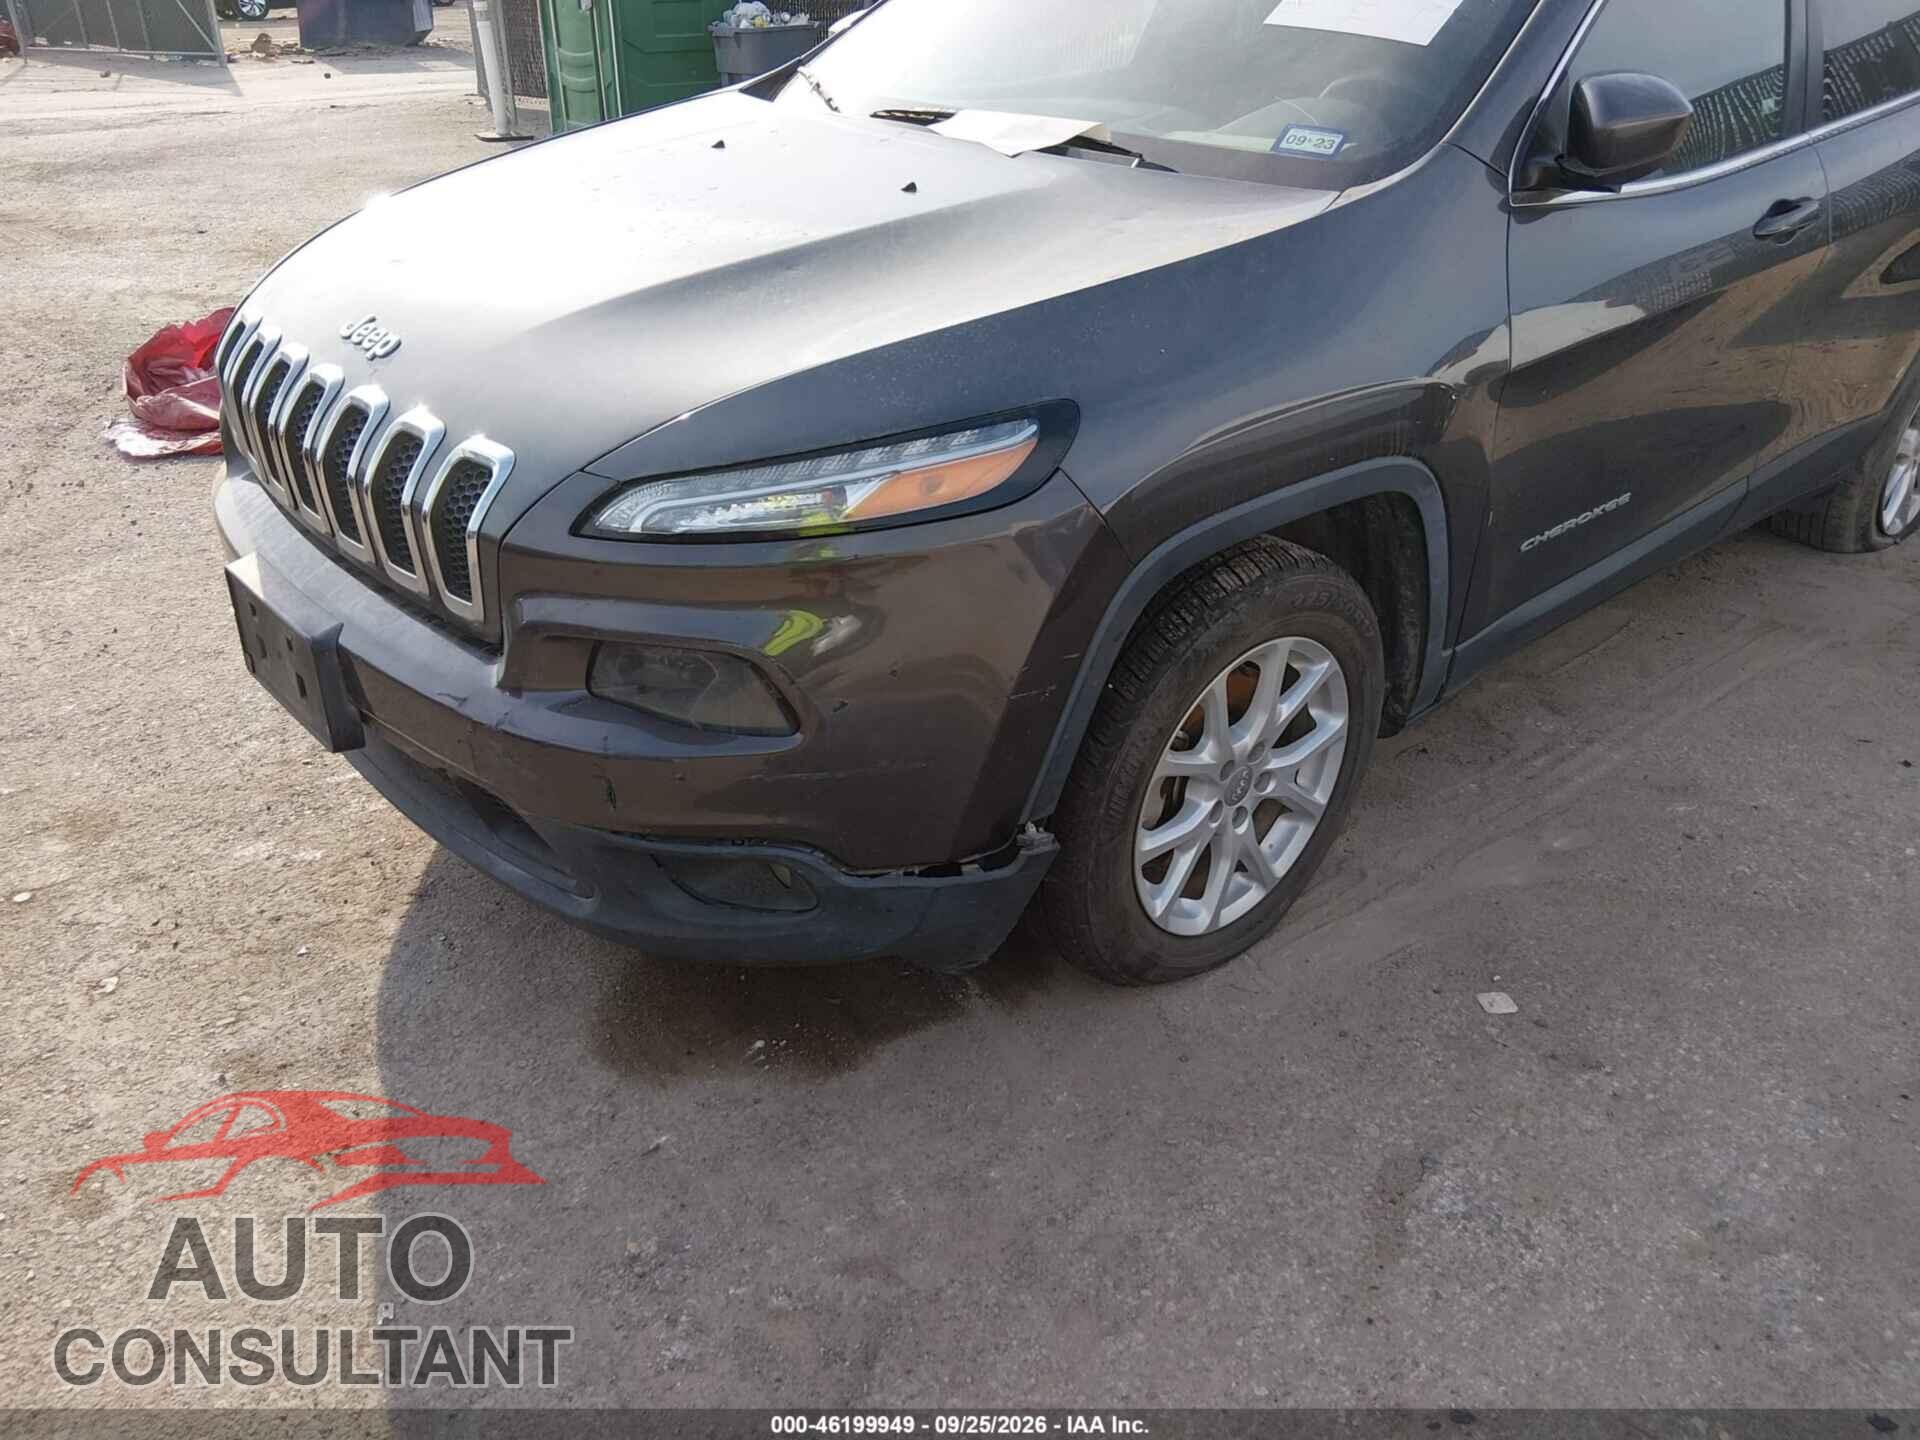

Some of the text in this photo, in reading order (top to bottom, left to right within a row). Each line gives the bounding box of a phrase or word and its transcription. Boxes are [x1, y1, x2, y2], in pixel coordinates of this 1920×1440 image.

[1286, 134, 1336, 150] 09 23
[339, 313, 402, 361] Jeep
[1519, 491, 1632, 552] CHEROKEE
